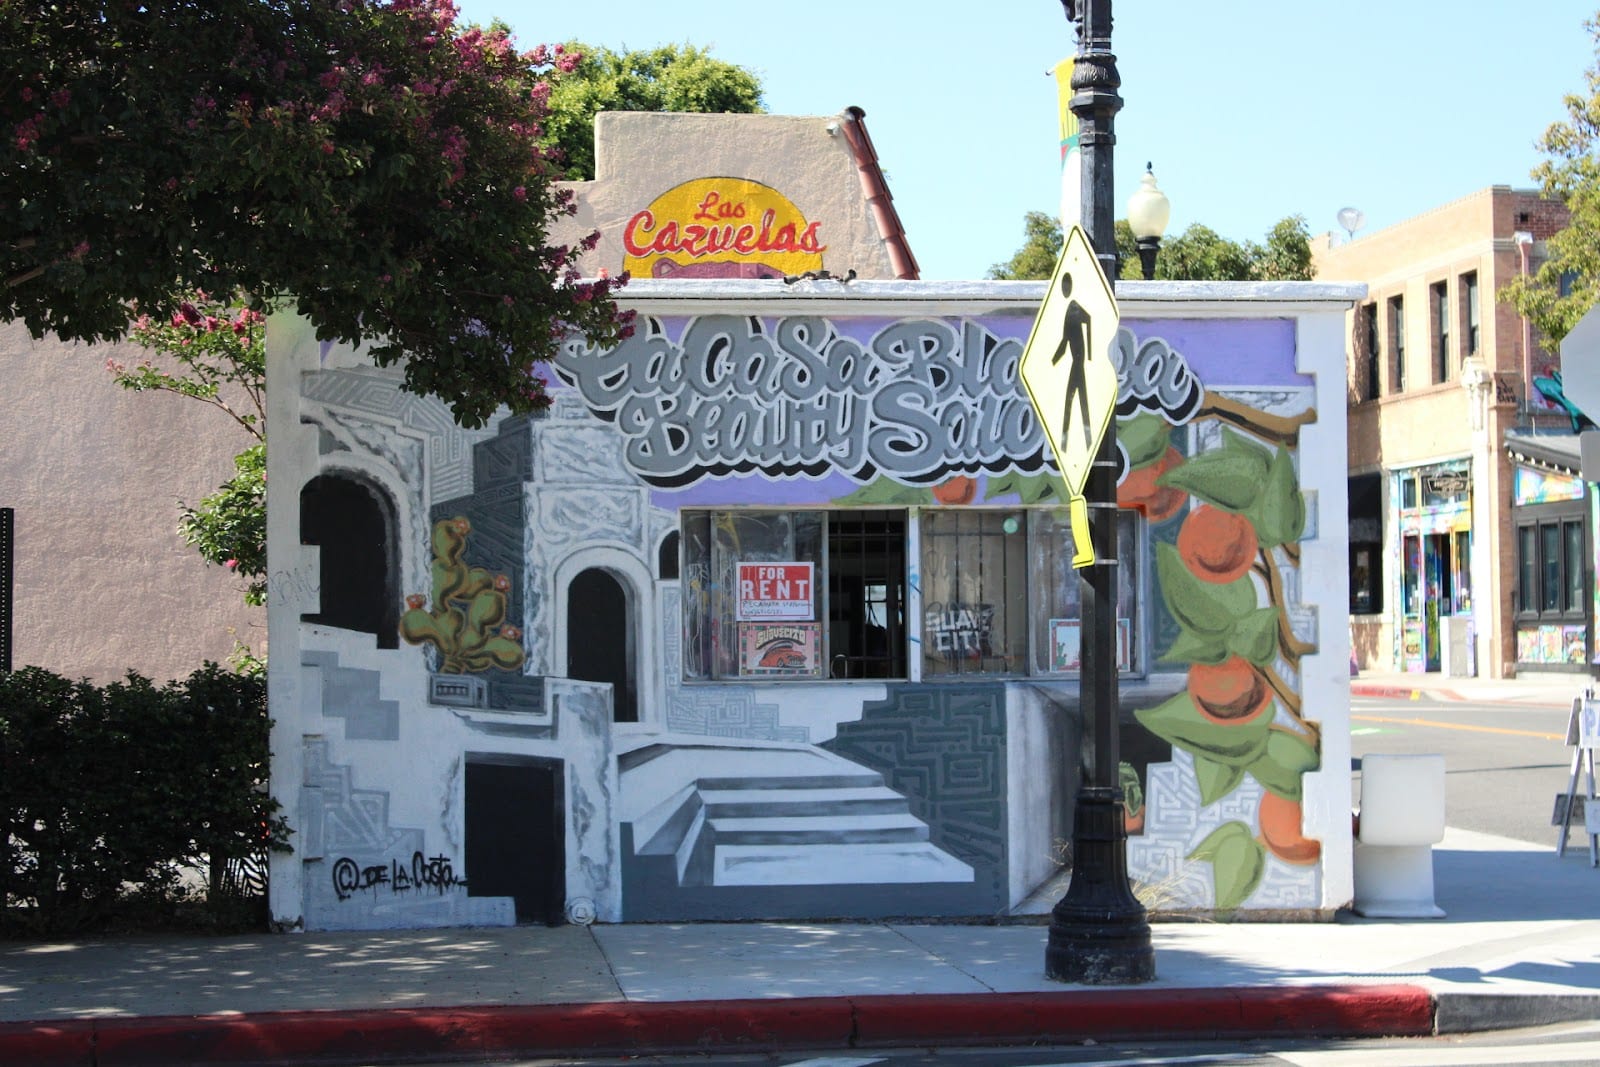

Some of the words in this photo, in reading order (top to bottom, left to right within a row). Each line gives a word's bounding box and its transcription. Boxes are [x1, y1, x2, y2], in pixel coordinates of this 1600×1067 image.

[694, 191, 746, 221] Las
[624, 208, 827, 257] Cazuelas
[870, 318, 1205, 425] Blaa
[617, 388, 878, 492] Beauty
[866, 380, 1122, 488] Salo
[741, 580, 809, 600] RENT
[758, 567, 785, 580] FOR
